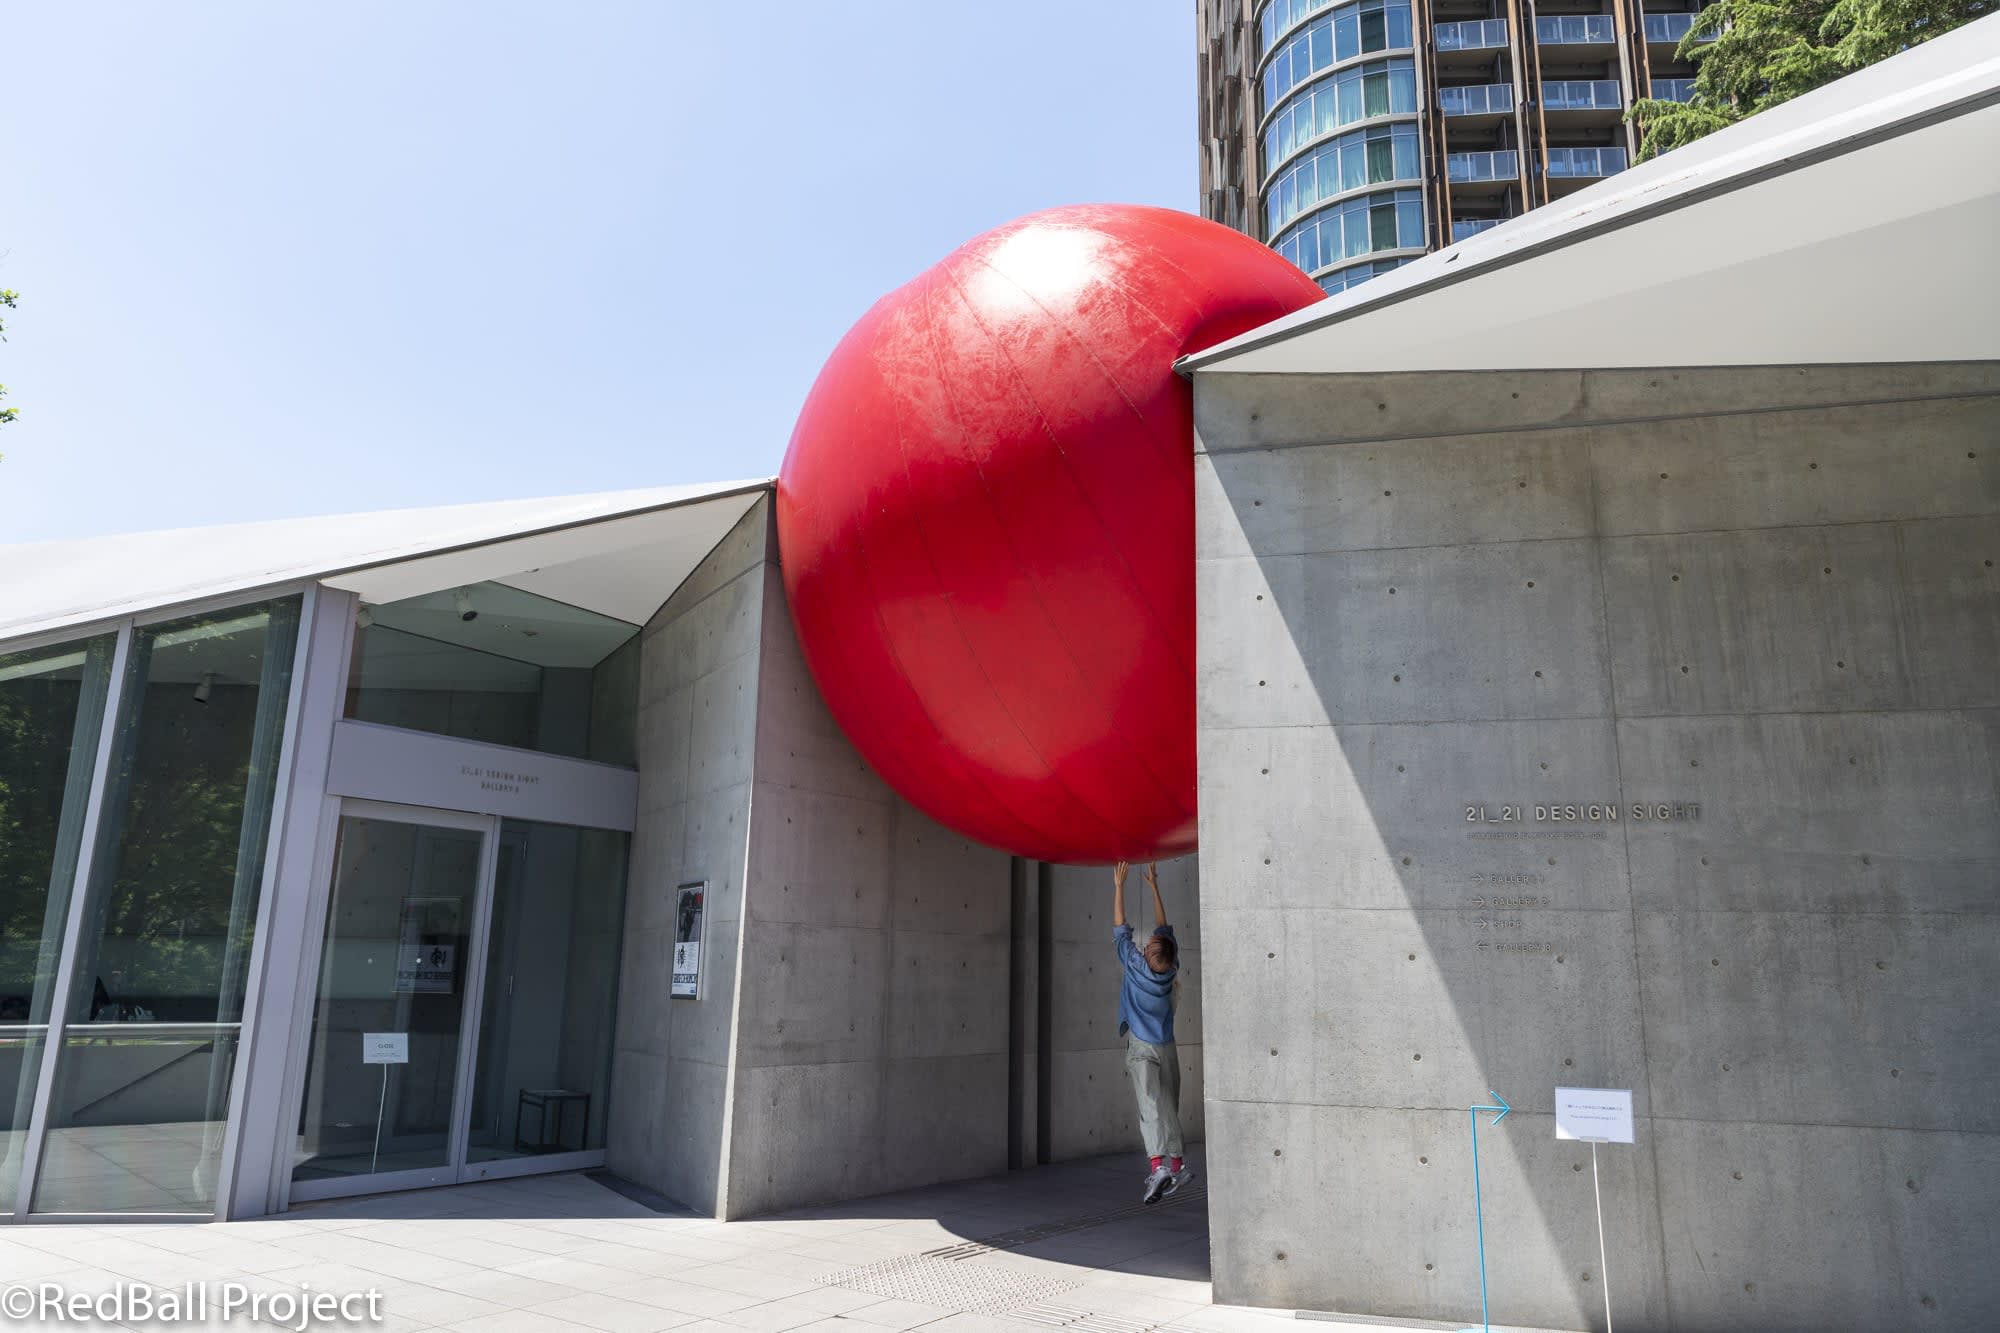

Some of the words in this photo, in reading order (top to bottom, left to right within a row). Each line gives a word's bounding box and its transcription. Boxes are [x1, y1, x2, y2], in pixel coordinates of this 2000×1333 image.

[1466, 806, 1521, 823] 21_21
[1535, 804, 1618, 822] DESIGN
[1632, 803, 1700, 821] SIGHT
